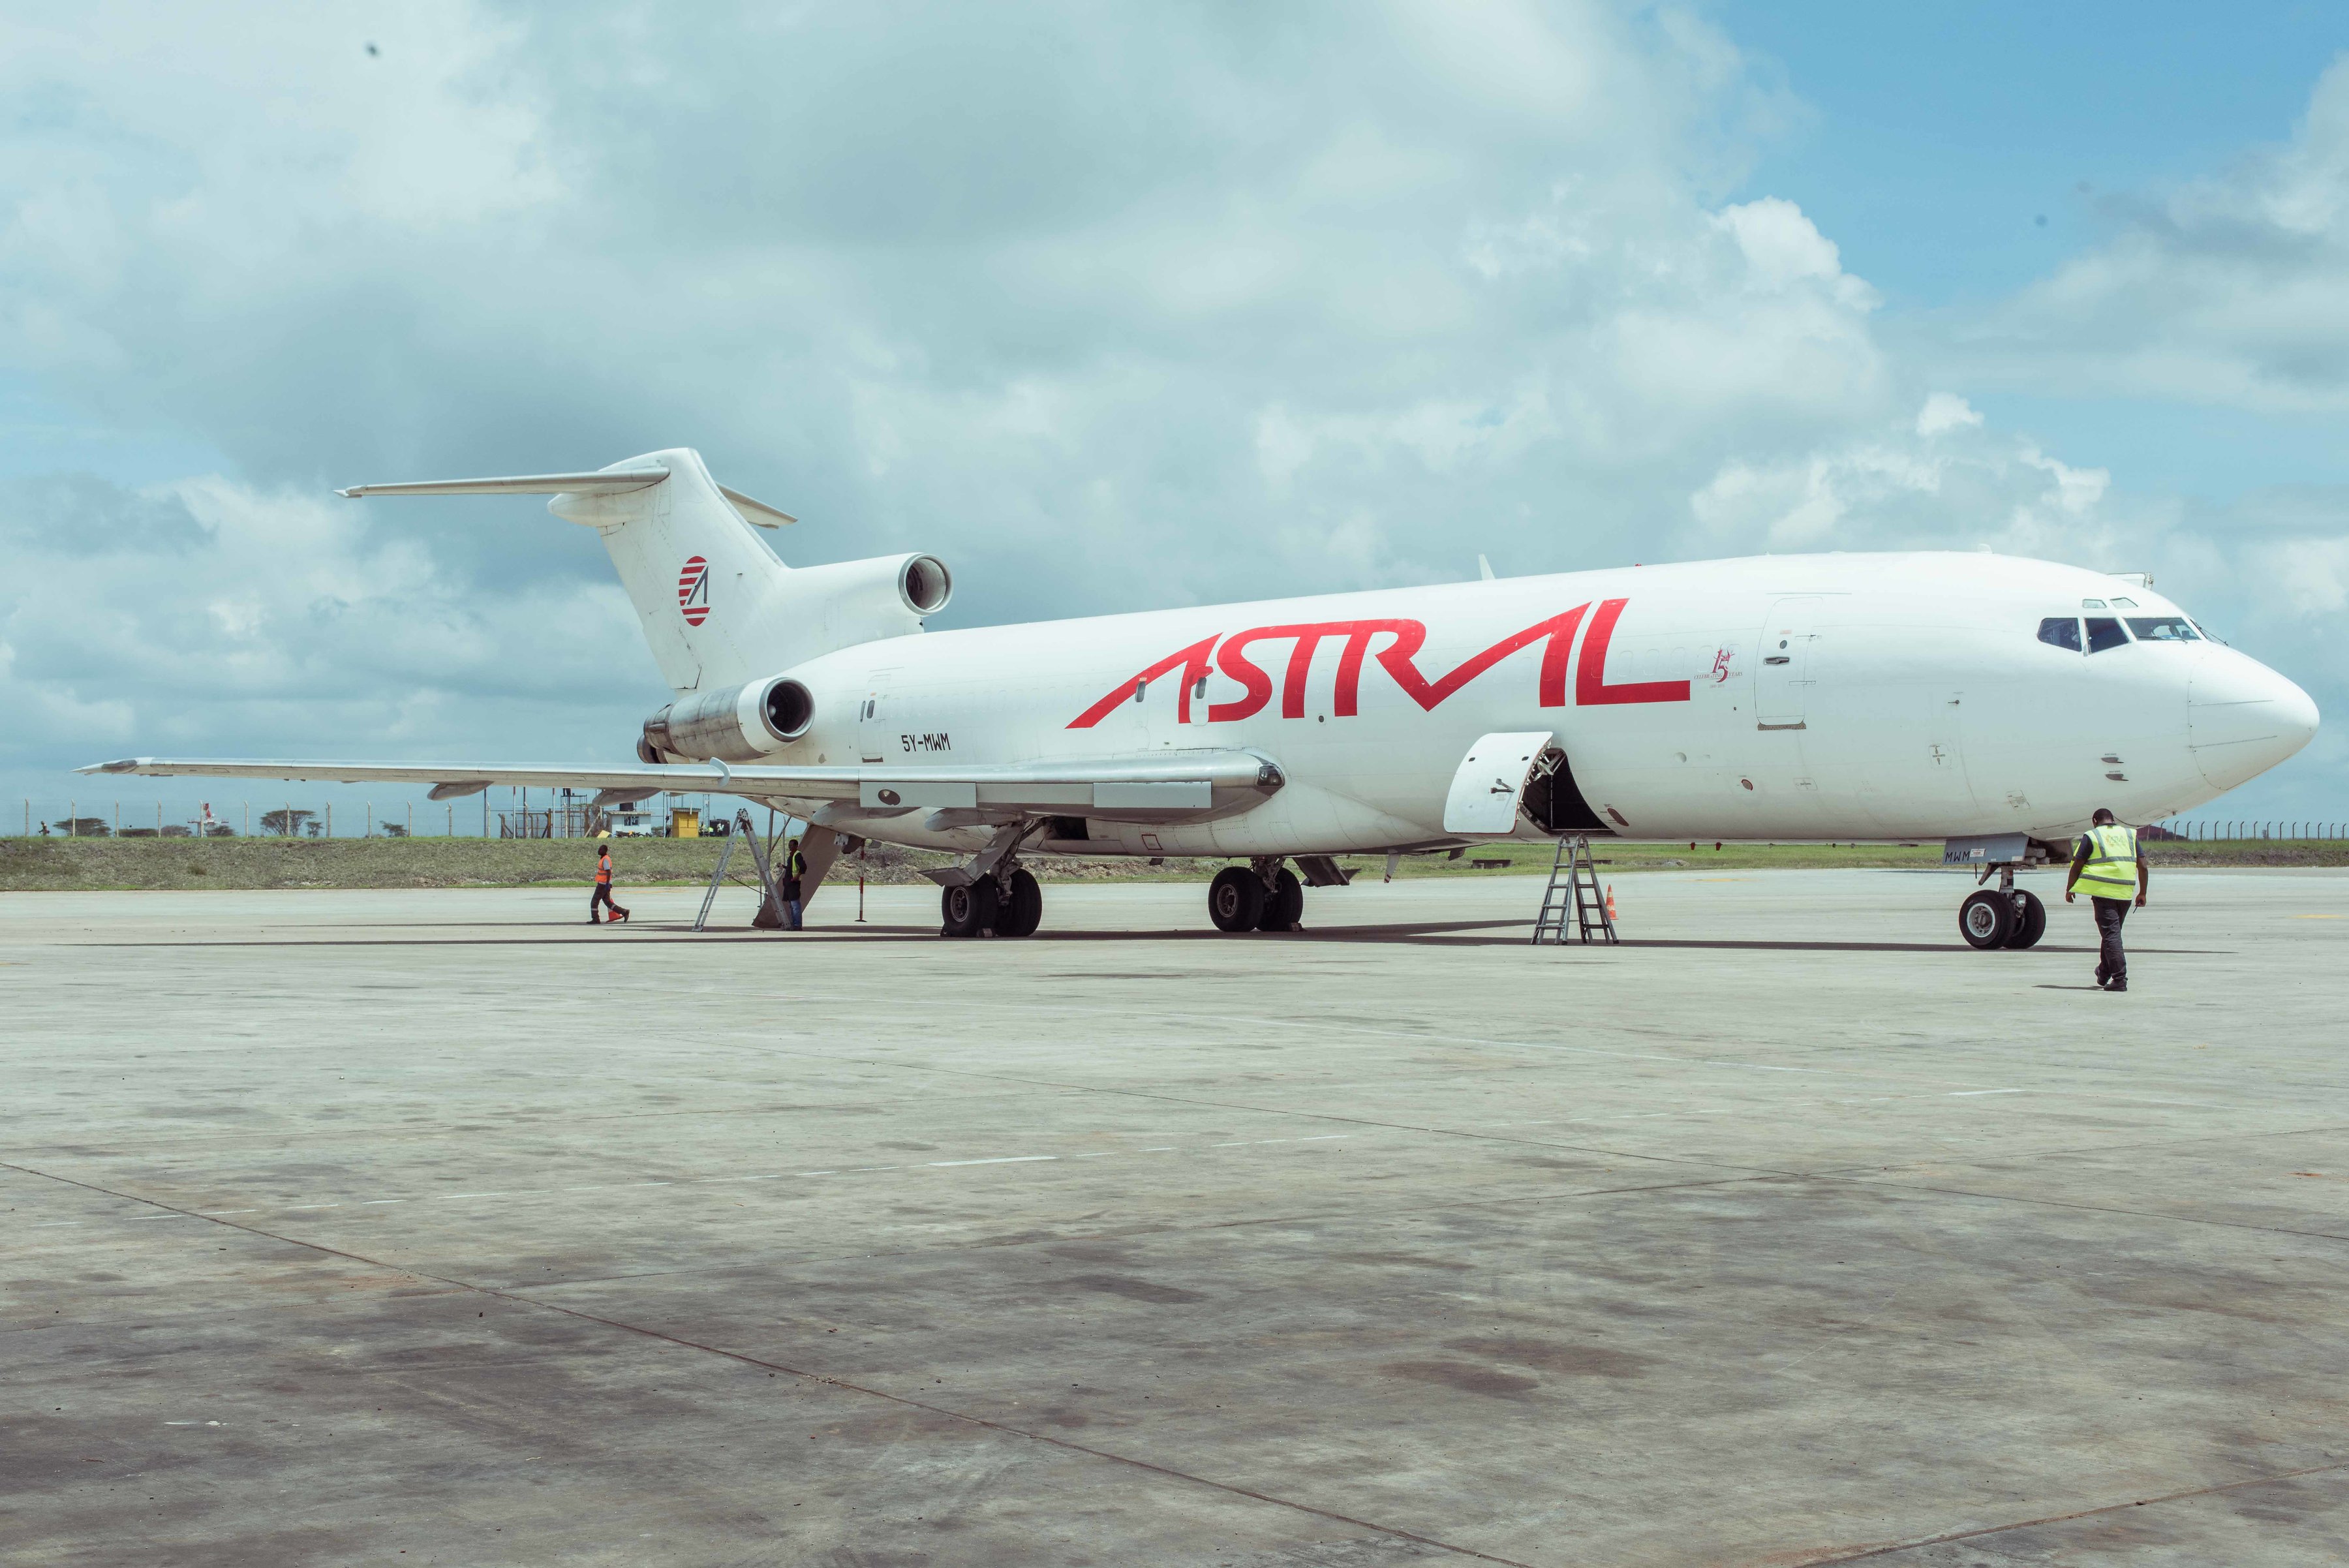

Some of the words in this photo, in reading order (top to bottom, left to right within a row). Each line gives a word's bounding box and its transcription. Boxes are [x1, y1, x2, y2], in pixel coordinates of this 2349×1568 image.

[1066, 598, 1690, 728] ASTRAL
[901, 733, 951, 752] 5Y-MWM
[1945, 851, 1970, 862] MWM
